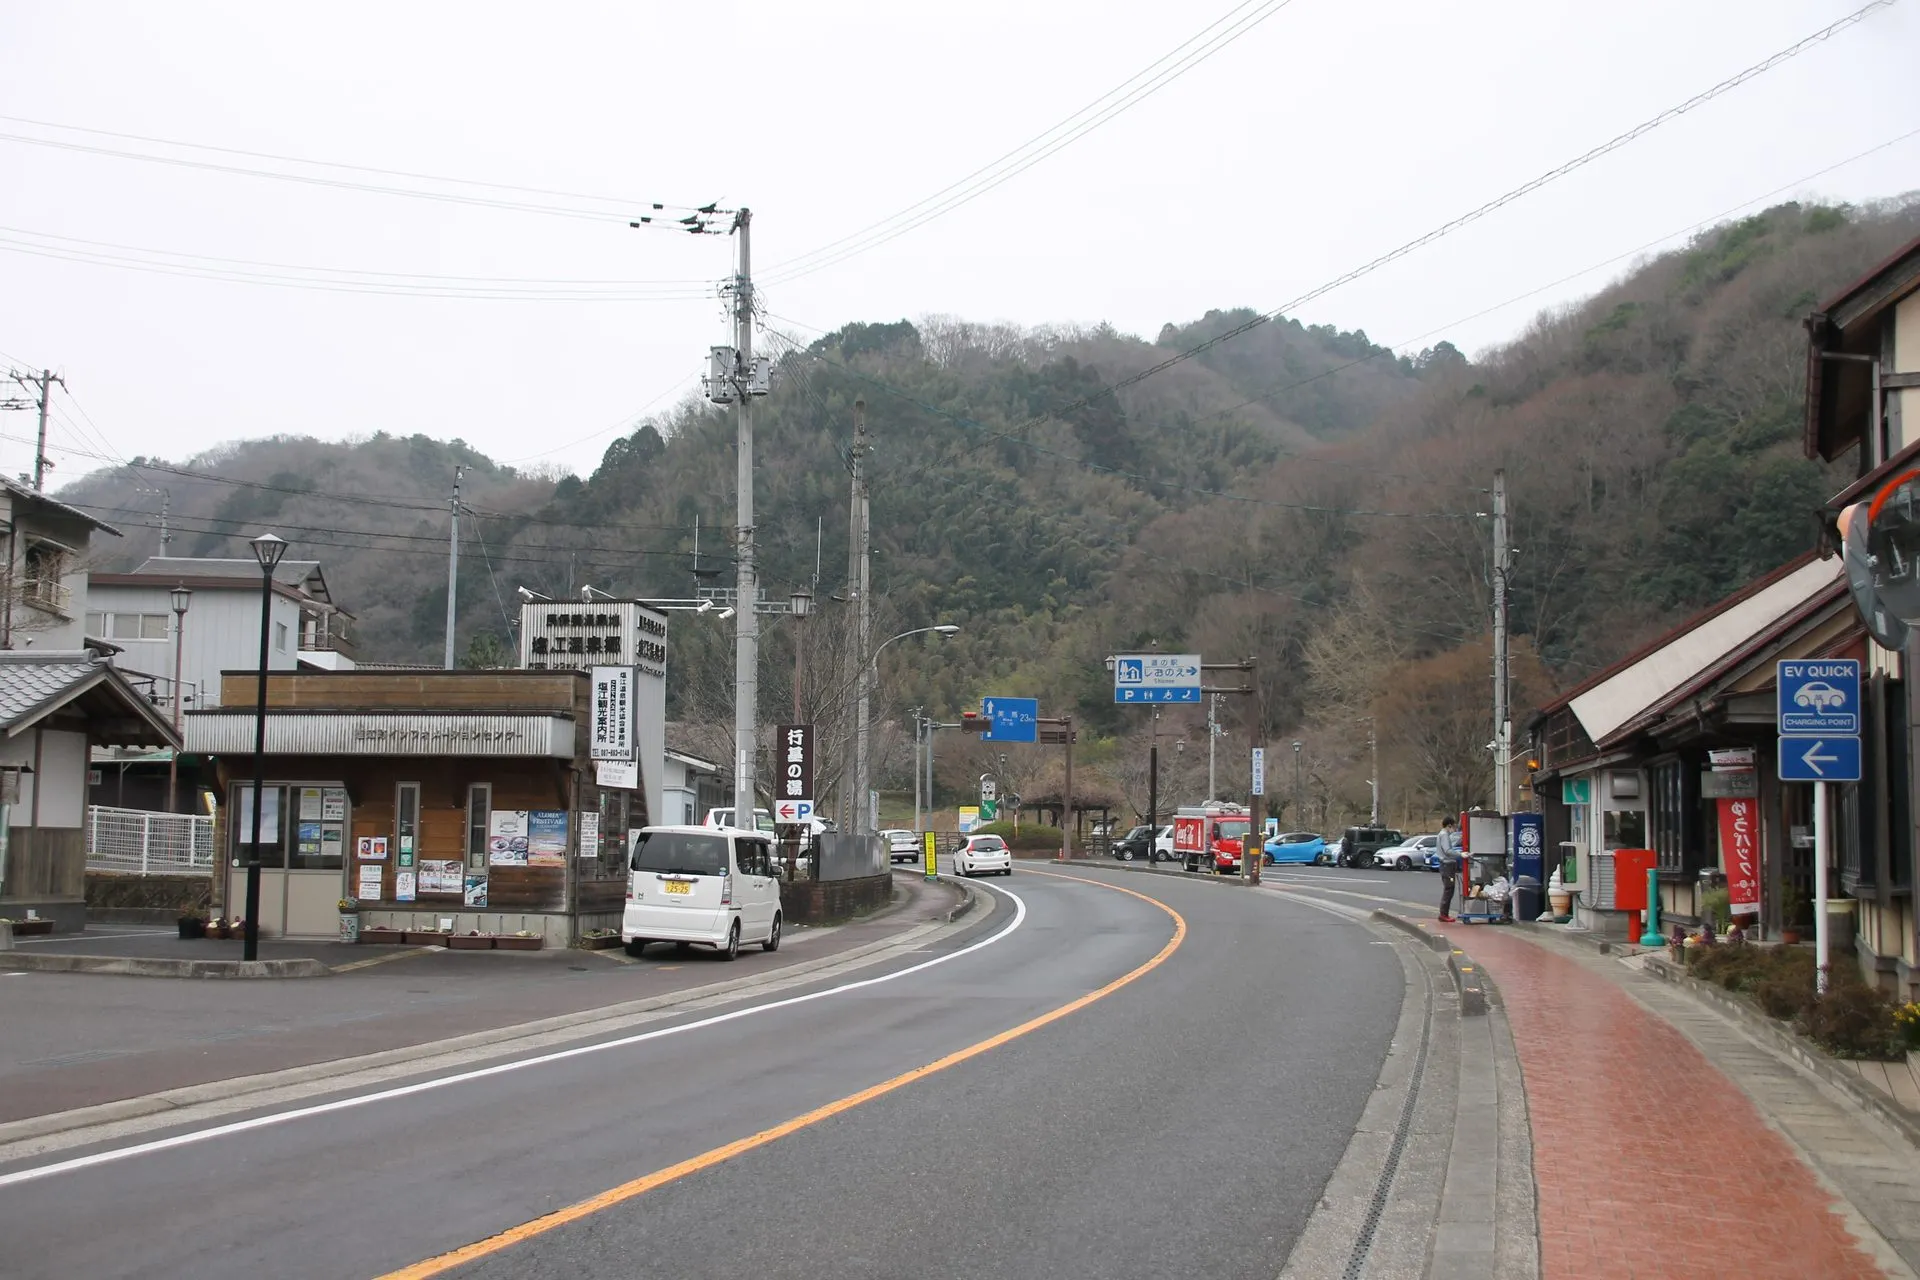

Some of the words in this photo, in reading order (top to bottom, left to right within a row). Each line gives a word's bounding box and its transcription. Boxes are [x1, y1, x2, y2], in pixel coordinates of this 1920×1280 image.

[1144, 668, 1185, 677] しおのえ
[1785, 666, 1803, 677] EV
[1807, 666, 1854, 677] QUICK
[1786, 718, 1827, 726] CHARGING
[797, 803, 811, 819] P
[1731, 801, 1752, 876] ゆうパック
[1518, 846, 1541, 855] BOSS
